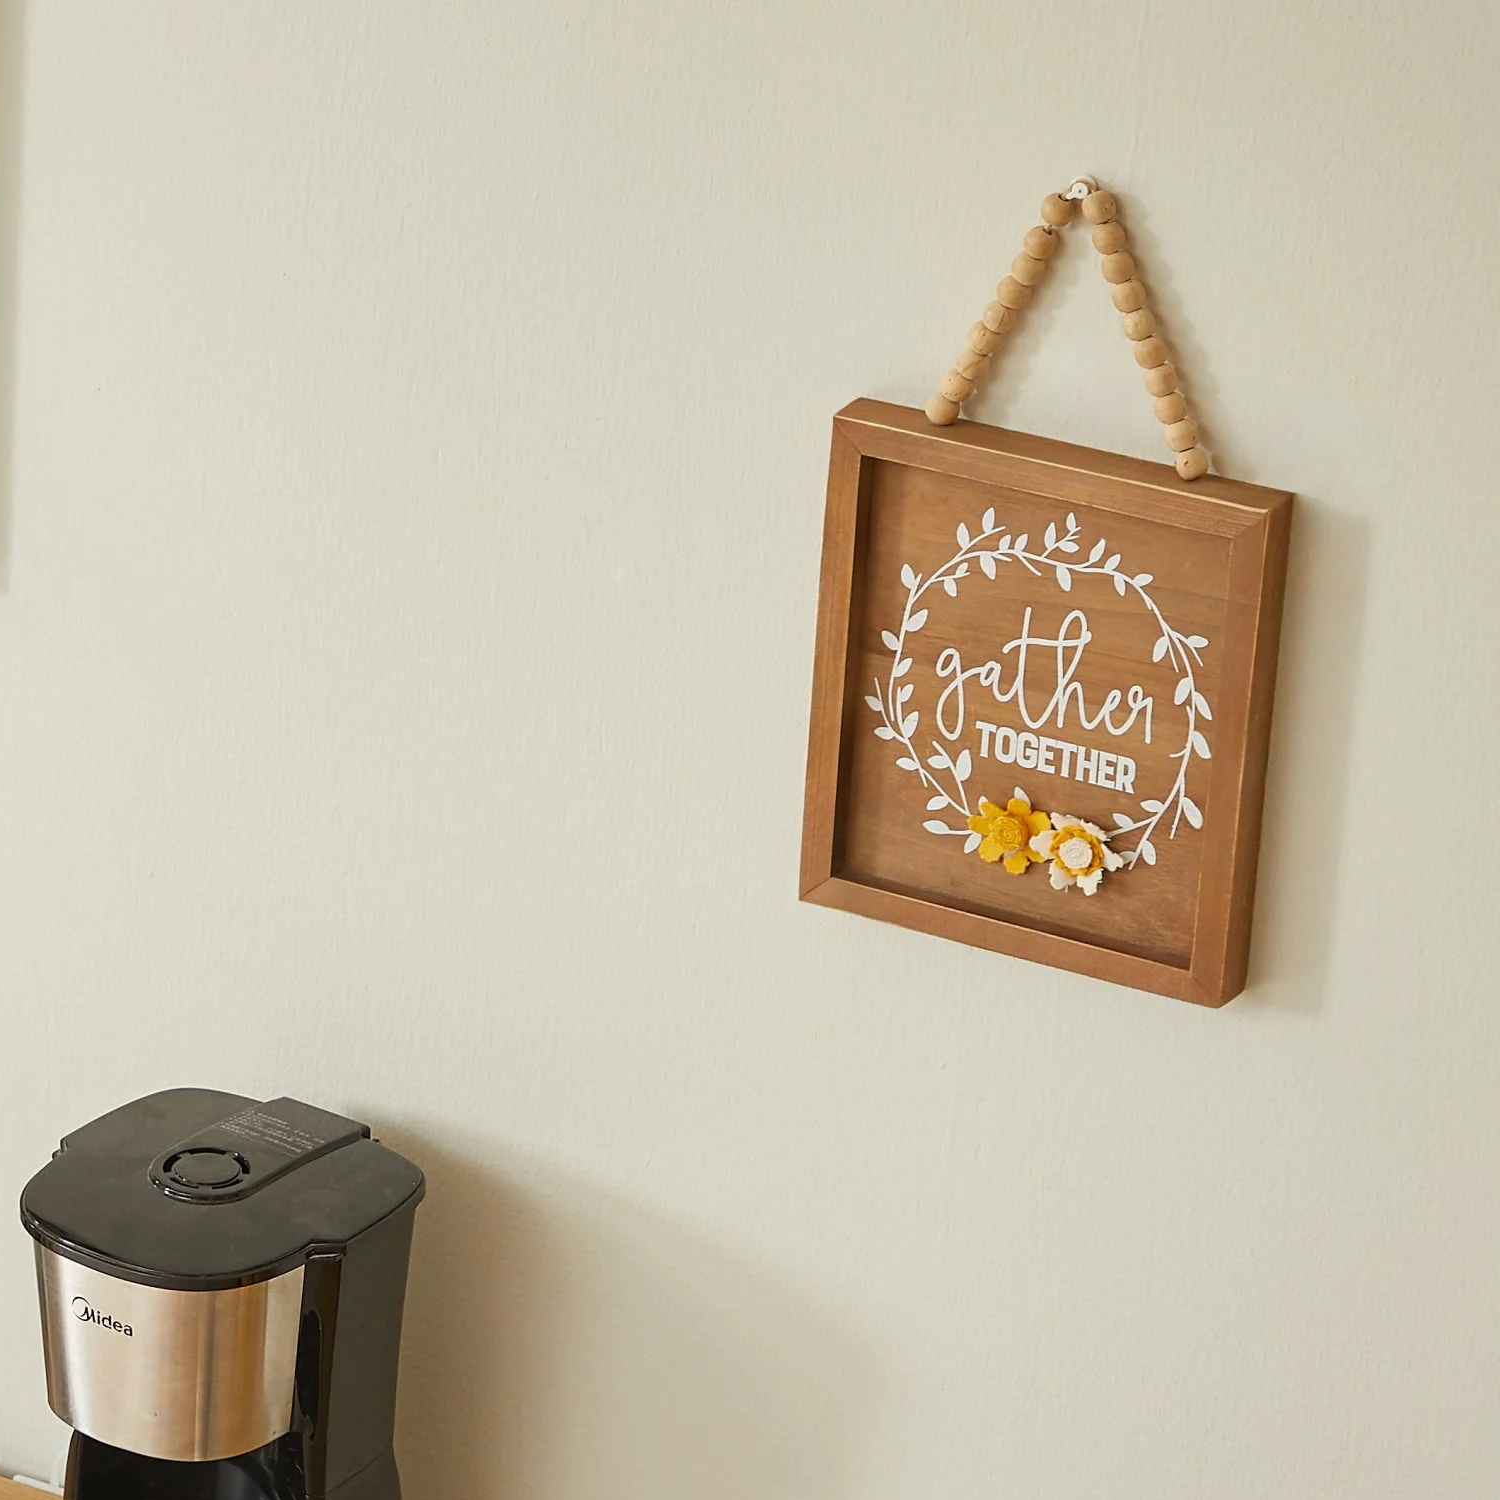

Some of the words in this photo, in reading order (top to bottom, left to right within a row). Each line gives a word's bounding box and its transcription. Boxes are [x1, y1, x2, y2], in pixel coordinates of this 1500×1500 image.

[935, 606, 1154, 744] gather
[975, 721, 1137, 794] TOGETHER
[72, 1297, 133, 1337] Midea
